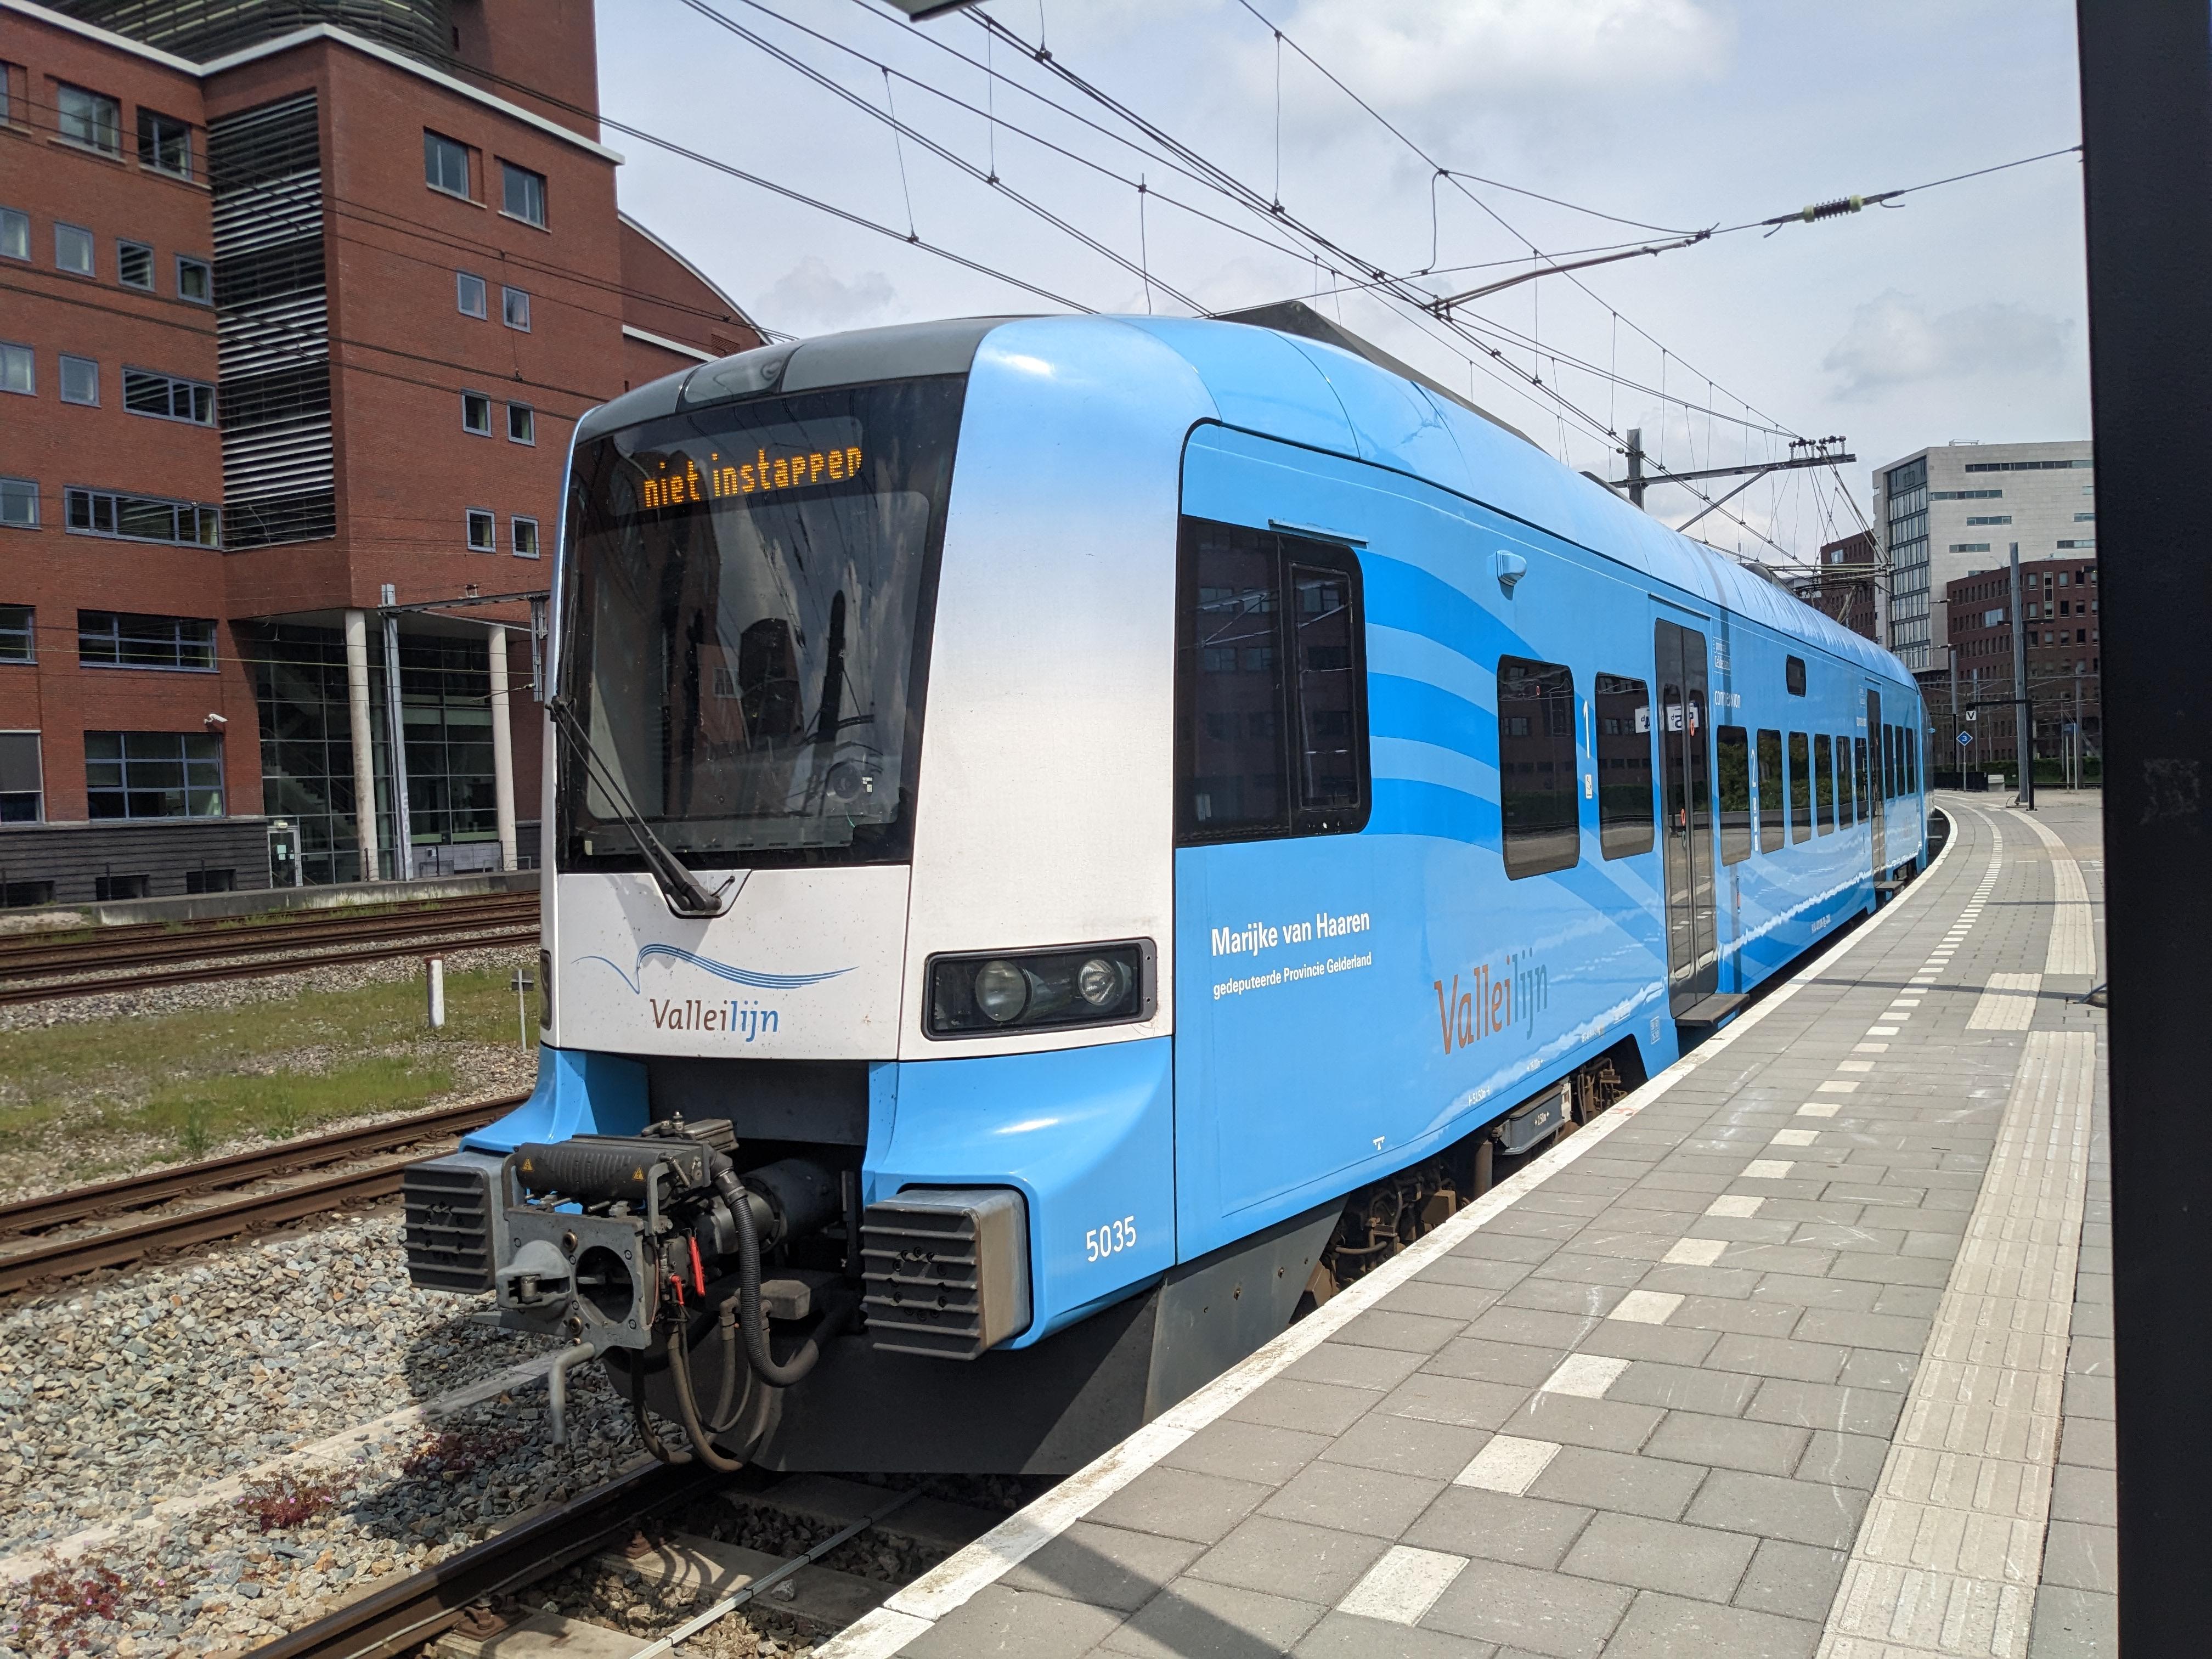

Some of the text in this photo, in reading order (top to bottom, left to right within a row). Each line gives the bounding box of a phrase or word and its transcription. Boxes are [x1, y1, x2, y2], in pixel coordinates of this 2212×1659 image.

[644, 447, 862, 507] niet instappen
[1583, 700, 1590, 759] 1
[1967, 712, 1975, 720] V
[1751, 749, 1756, 787] 2
[1211, 912, 1370, 956] Marijke van Haaren
[1213, 951, 1372, 1000] gedeputeerde Provincie Gelderland
[650, 998, 779, 1042] Valleilijn
[1434, 947, 1548, 1055] Valleilijn
[1086, 1215, 1136, 1262] 5035
